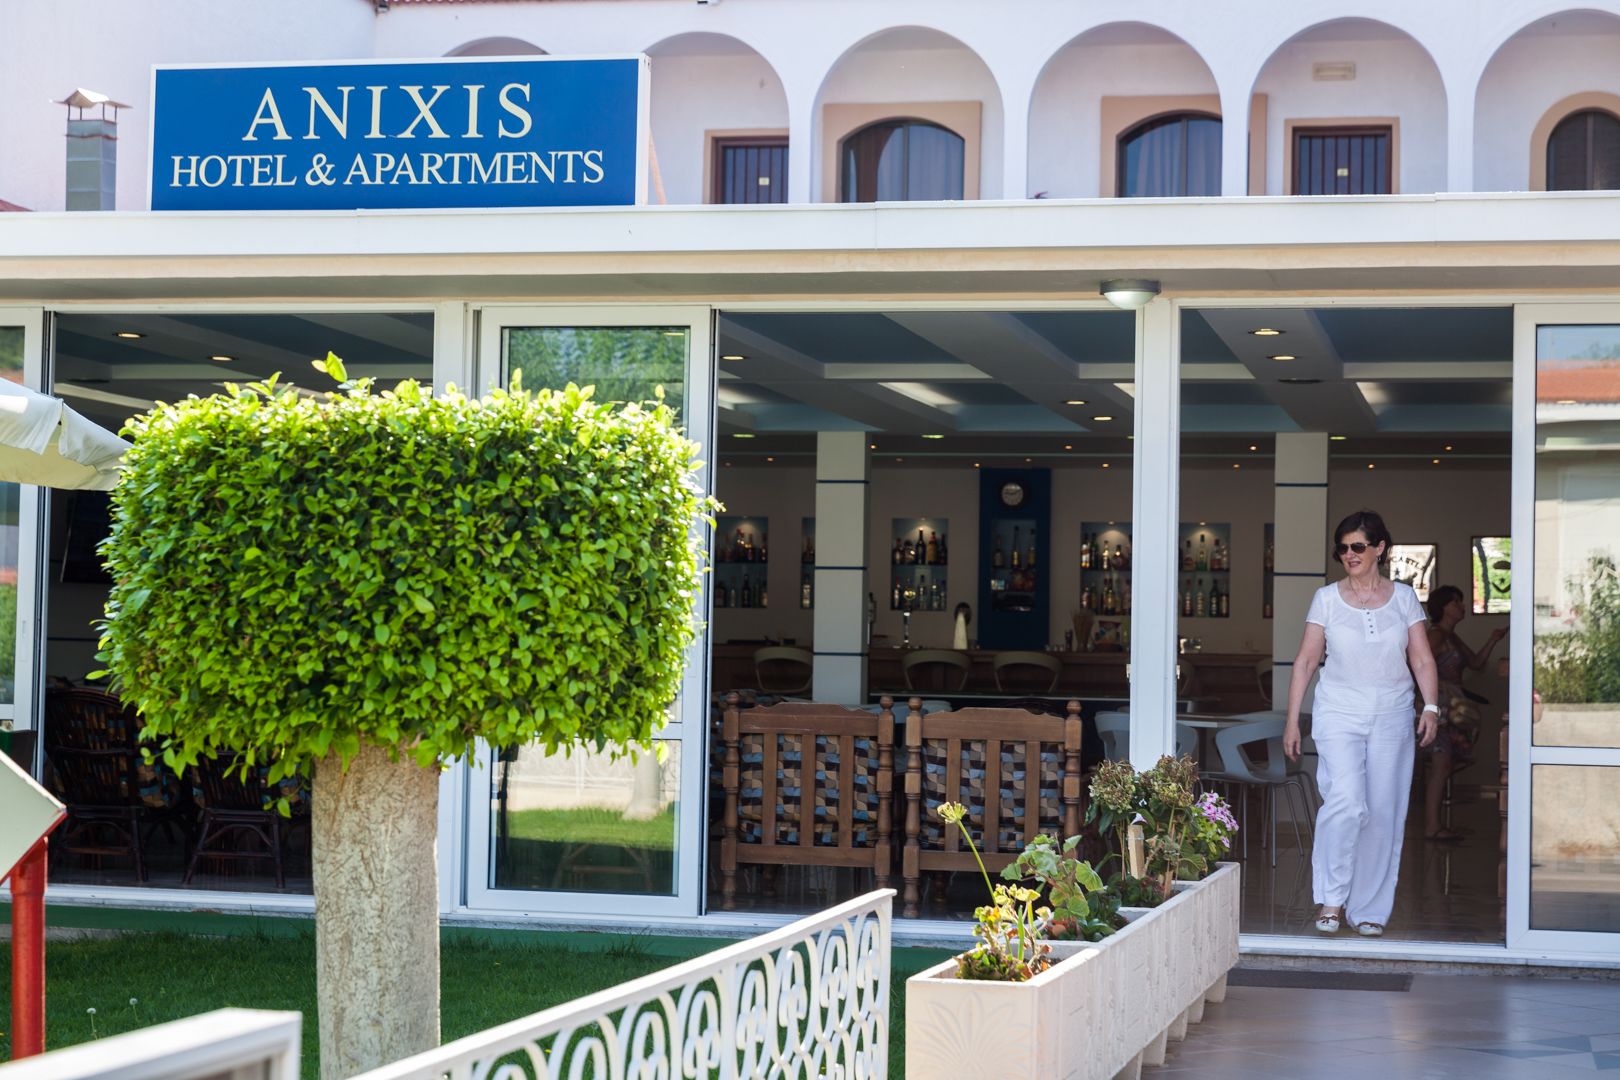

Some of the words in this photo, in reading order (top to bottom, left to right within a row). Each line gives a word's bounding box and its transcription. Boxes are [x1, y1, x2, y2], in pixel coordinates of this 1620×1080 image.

[242, 83, 533, 140] ANIXIS
[169, 154, 297, 187] HOTEL
[305, 153, 337, 186] &
[343, 150, 605, 185] APARTMENTS
